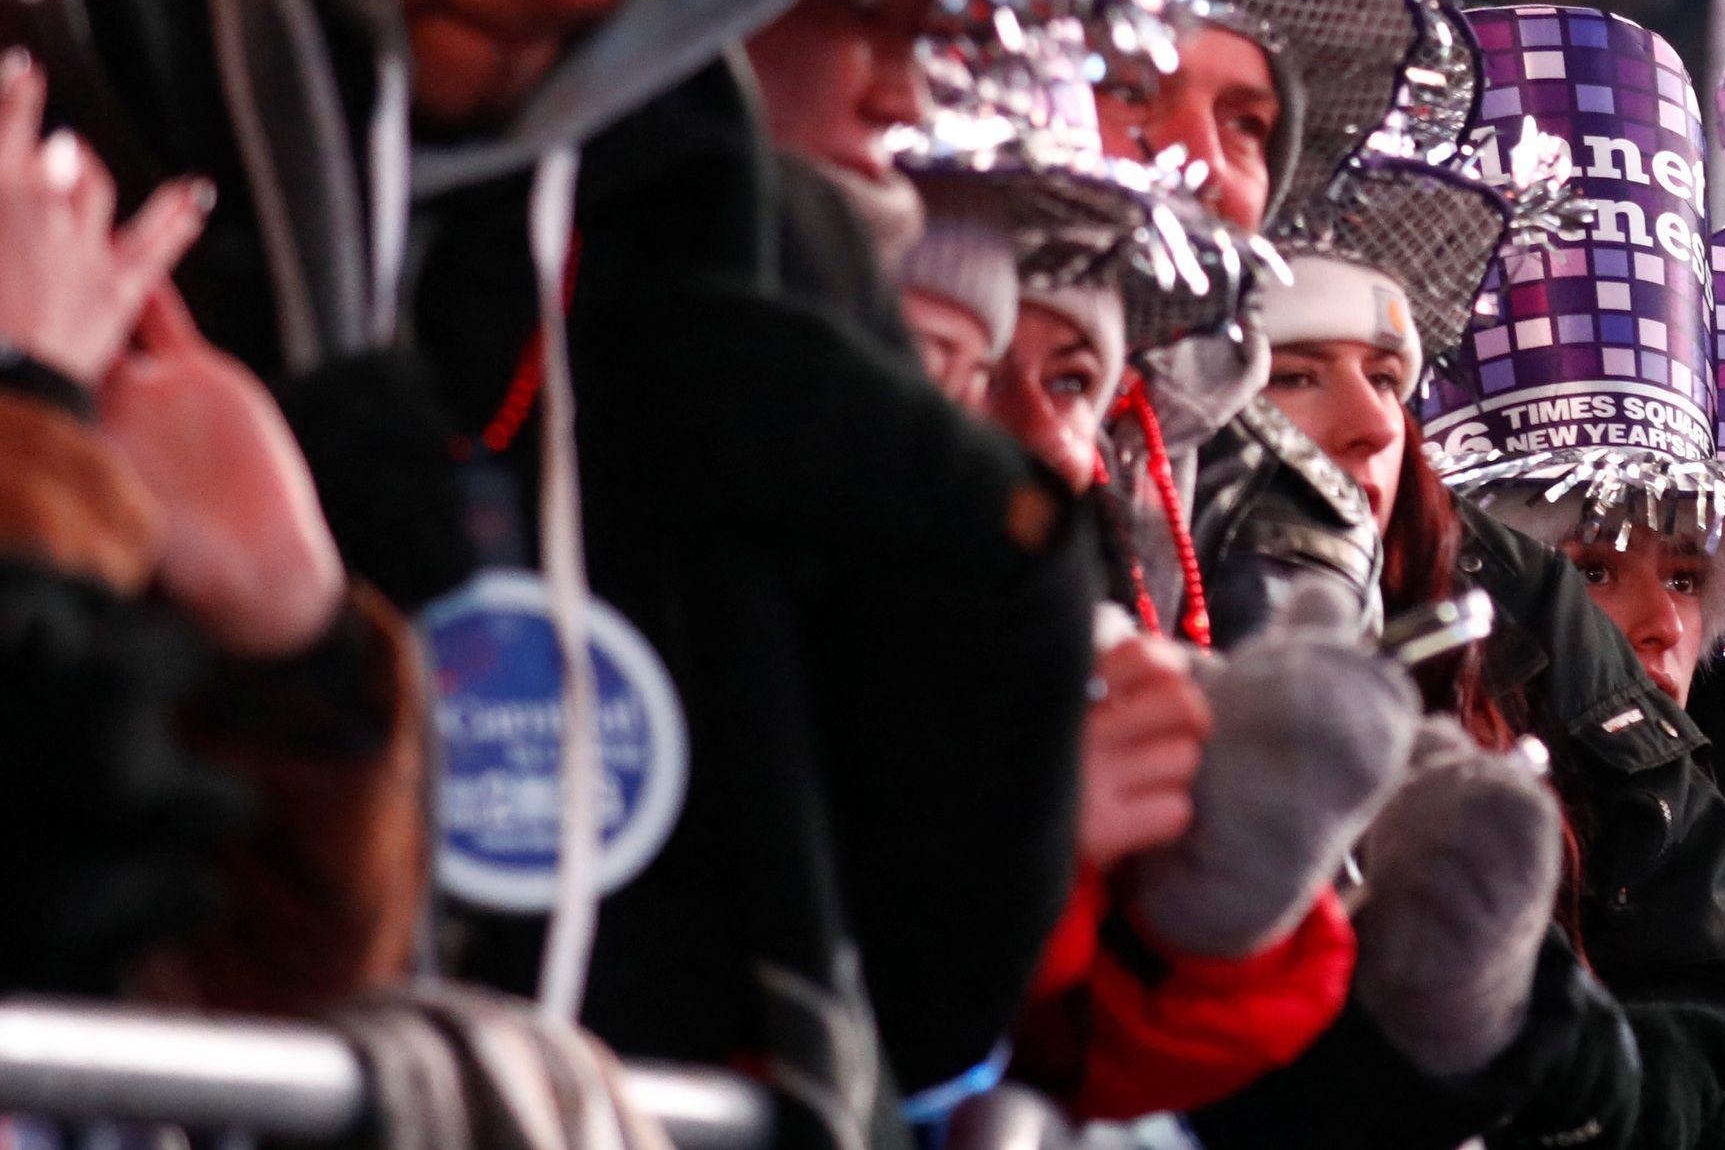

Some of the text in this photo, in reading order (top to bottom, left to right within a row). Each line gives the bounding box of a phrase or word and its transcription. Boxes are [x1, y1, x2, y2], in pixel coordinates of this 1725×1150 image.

[1502, 395, 1617, 430] TIMES
[1506, 423, 1578, 452] NEW
[1584, 422, 1685, 457] YEAR'S
